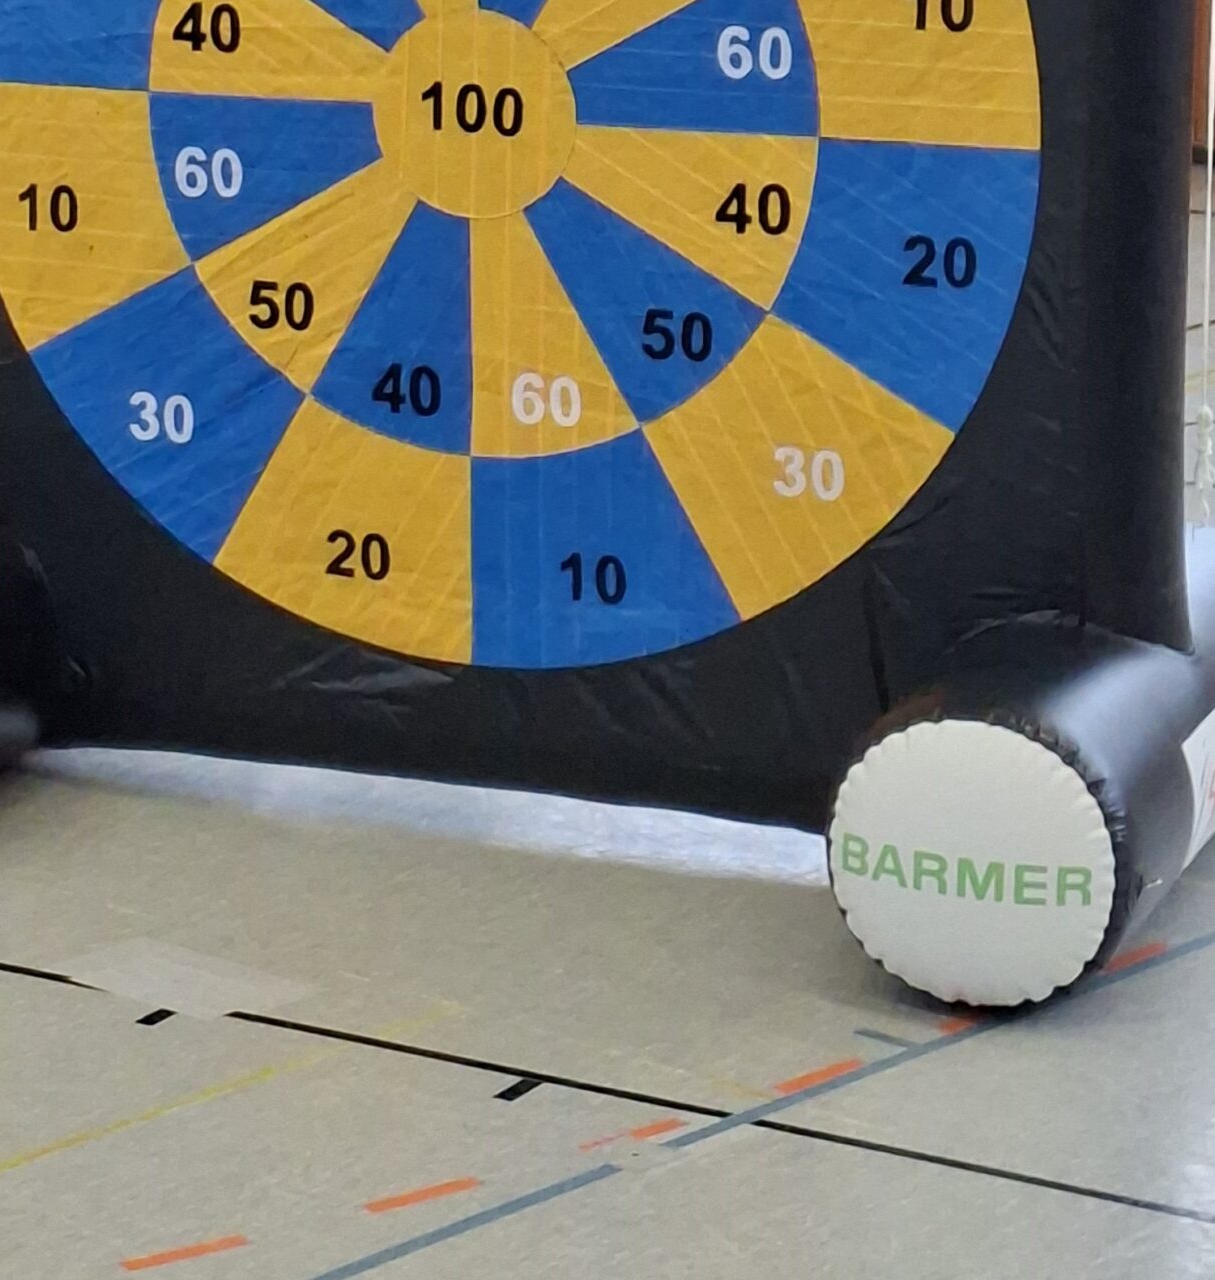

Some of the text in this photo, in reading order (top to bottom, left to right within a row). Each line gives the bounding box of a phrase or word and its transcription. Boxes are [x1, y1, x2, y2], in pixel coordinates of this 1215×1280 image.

[171, 2, 241, 54] 40
[716, 25, 793, 81] 60
[420, 81, 524, 138] 100
[174, 146, 244, 199] 60
[18, 183, 79, 233] 10
[714, 182, 791, 236] 40
[902, 235, 977, 289] 20
[248, 279, 315, 332] 50
[642, 308, 713, 363] 50
[129, 391, 194, 444] 30
[371, 363, 442, 418] 40
[511, 372, 582, 427] 60
[773, 446, 844, 501] 30
[325, 529, 391, 581] 20
[560, 552, 627, 605] 10
[840, 831, 1094, 908] BARMER
